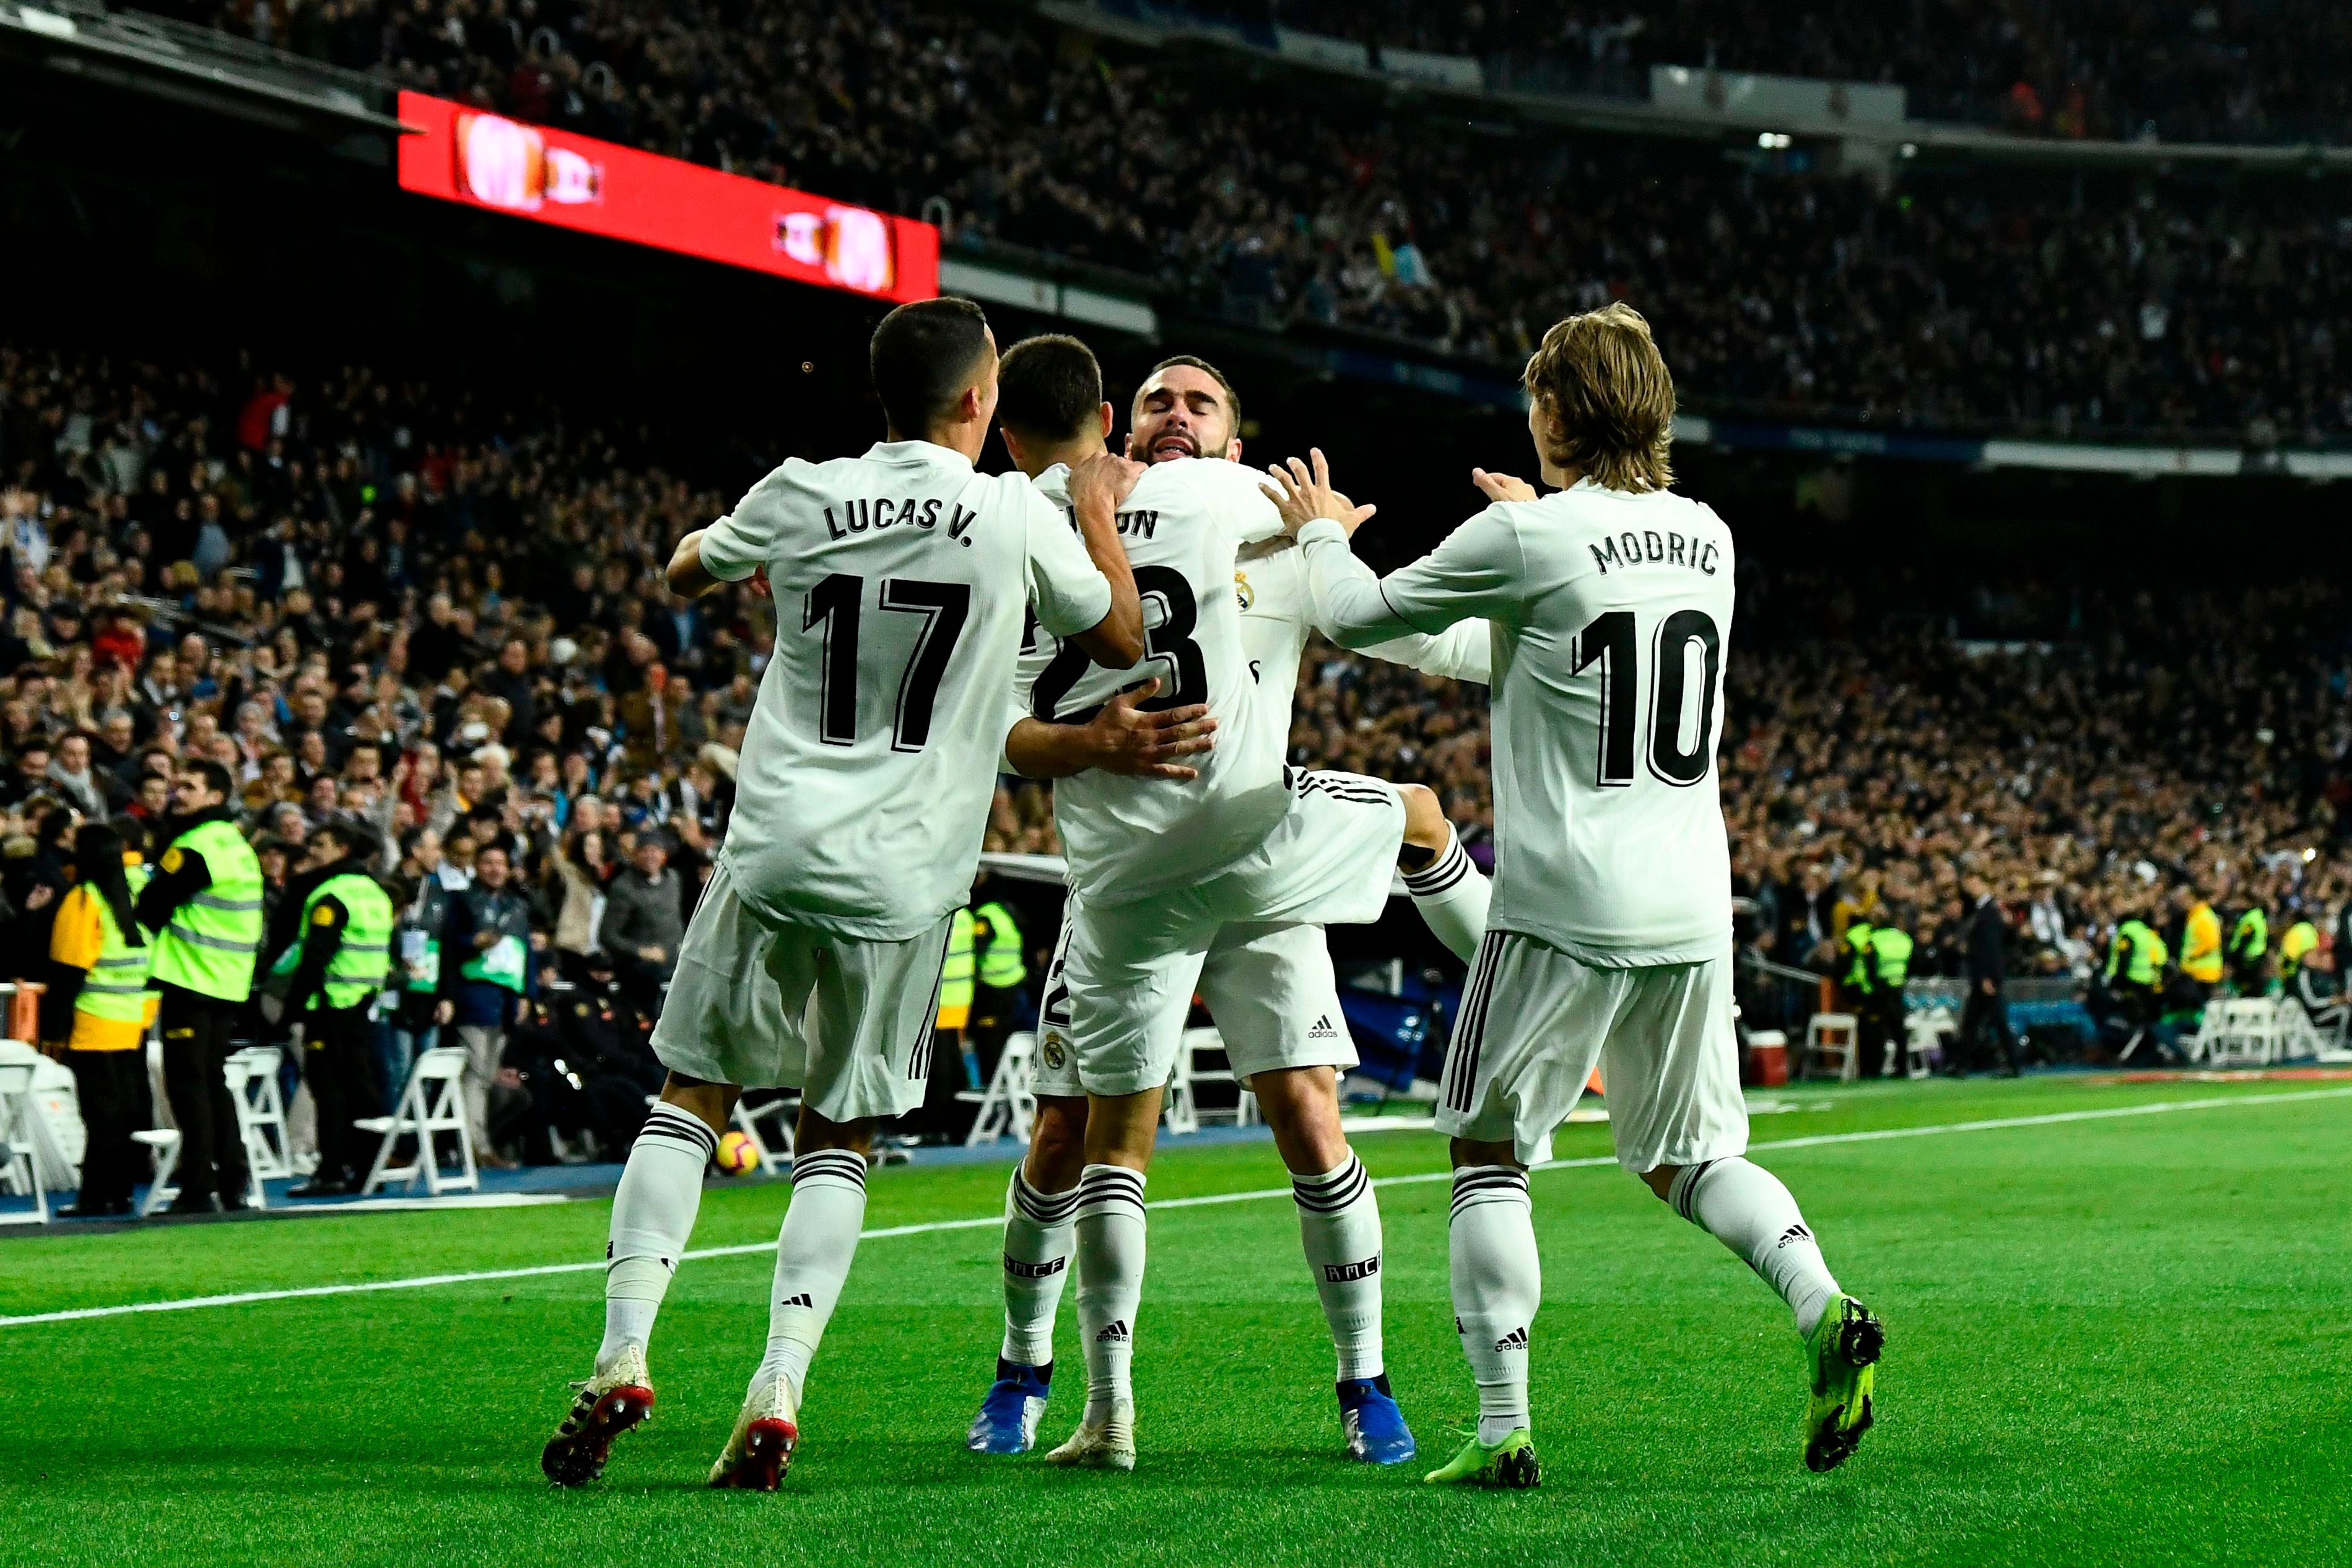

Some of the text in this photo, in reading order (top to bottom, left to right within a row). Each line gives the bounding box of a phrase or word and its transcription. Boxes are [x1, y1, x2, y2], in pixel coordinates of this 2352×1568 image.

[823, 498, 977, 547] LUCAS V.
[802, 573, 970, 752] 17
[1572, 610, 1720, 786] 10
[1308, 1029, 1338, 1039] adidas
